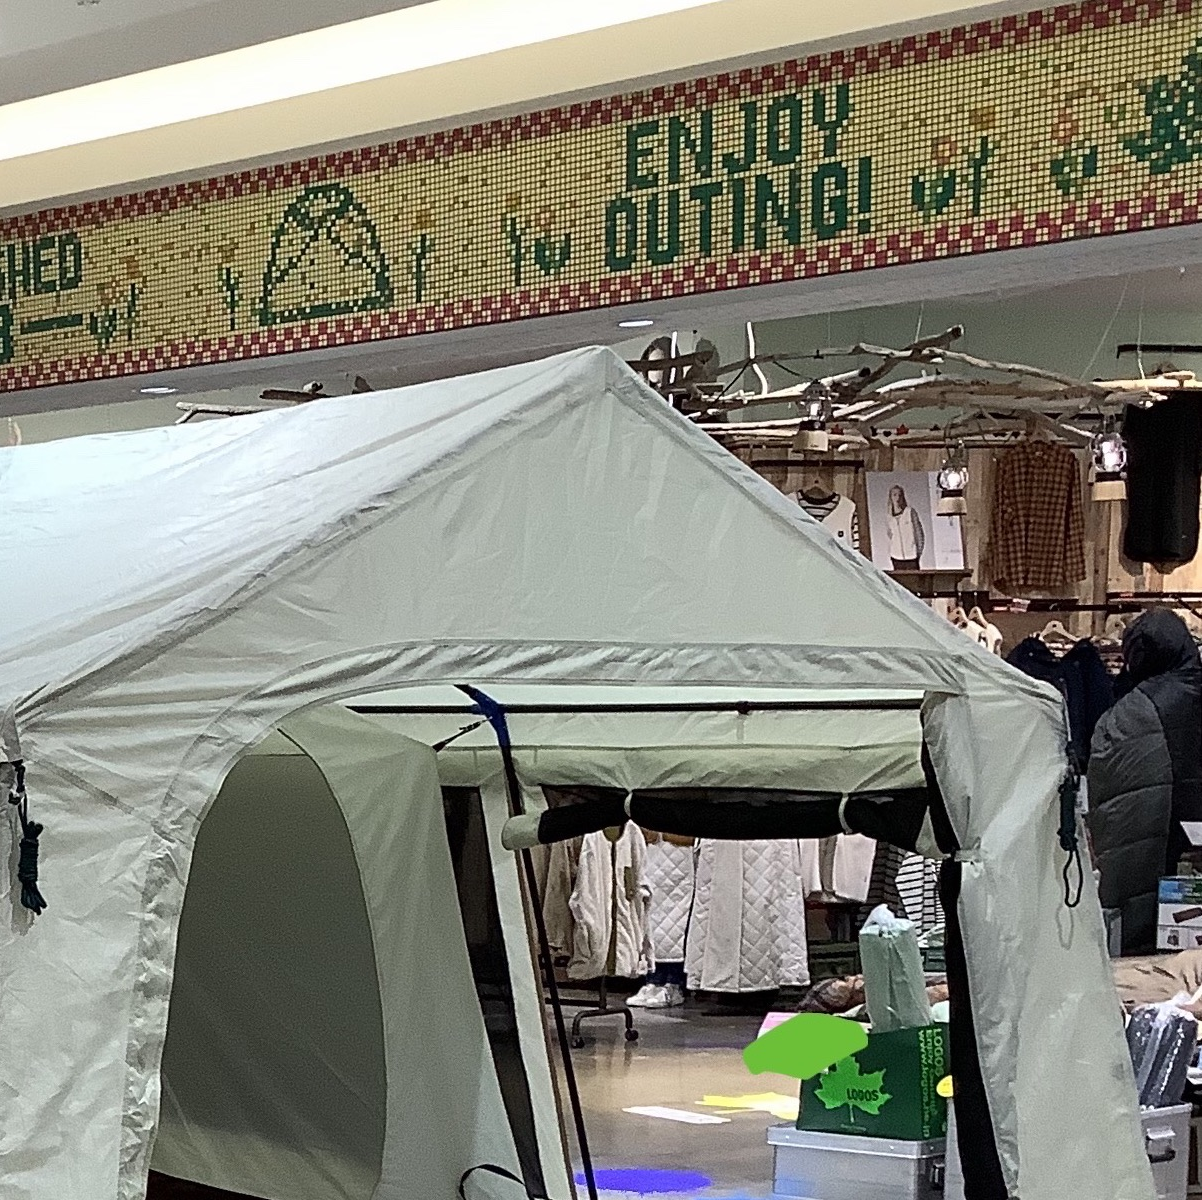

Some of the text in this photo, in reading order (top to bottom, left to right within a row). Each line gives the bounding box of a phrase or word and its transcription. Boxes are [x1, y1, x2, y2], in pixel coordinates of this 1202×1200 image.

[625, 83, 850, 192] ENJOY
[604, 156, 872, 272] OUTING!
[846, 1087, 880, 1102] LOGOS
